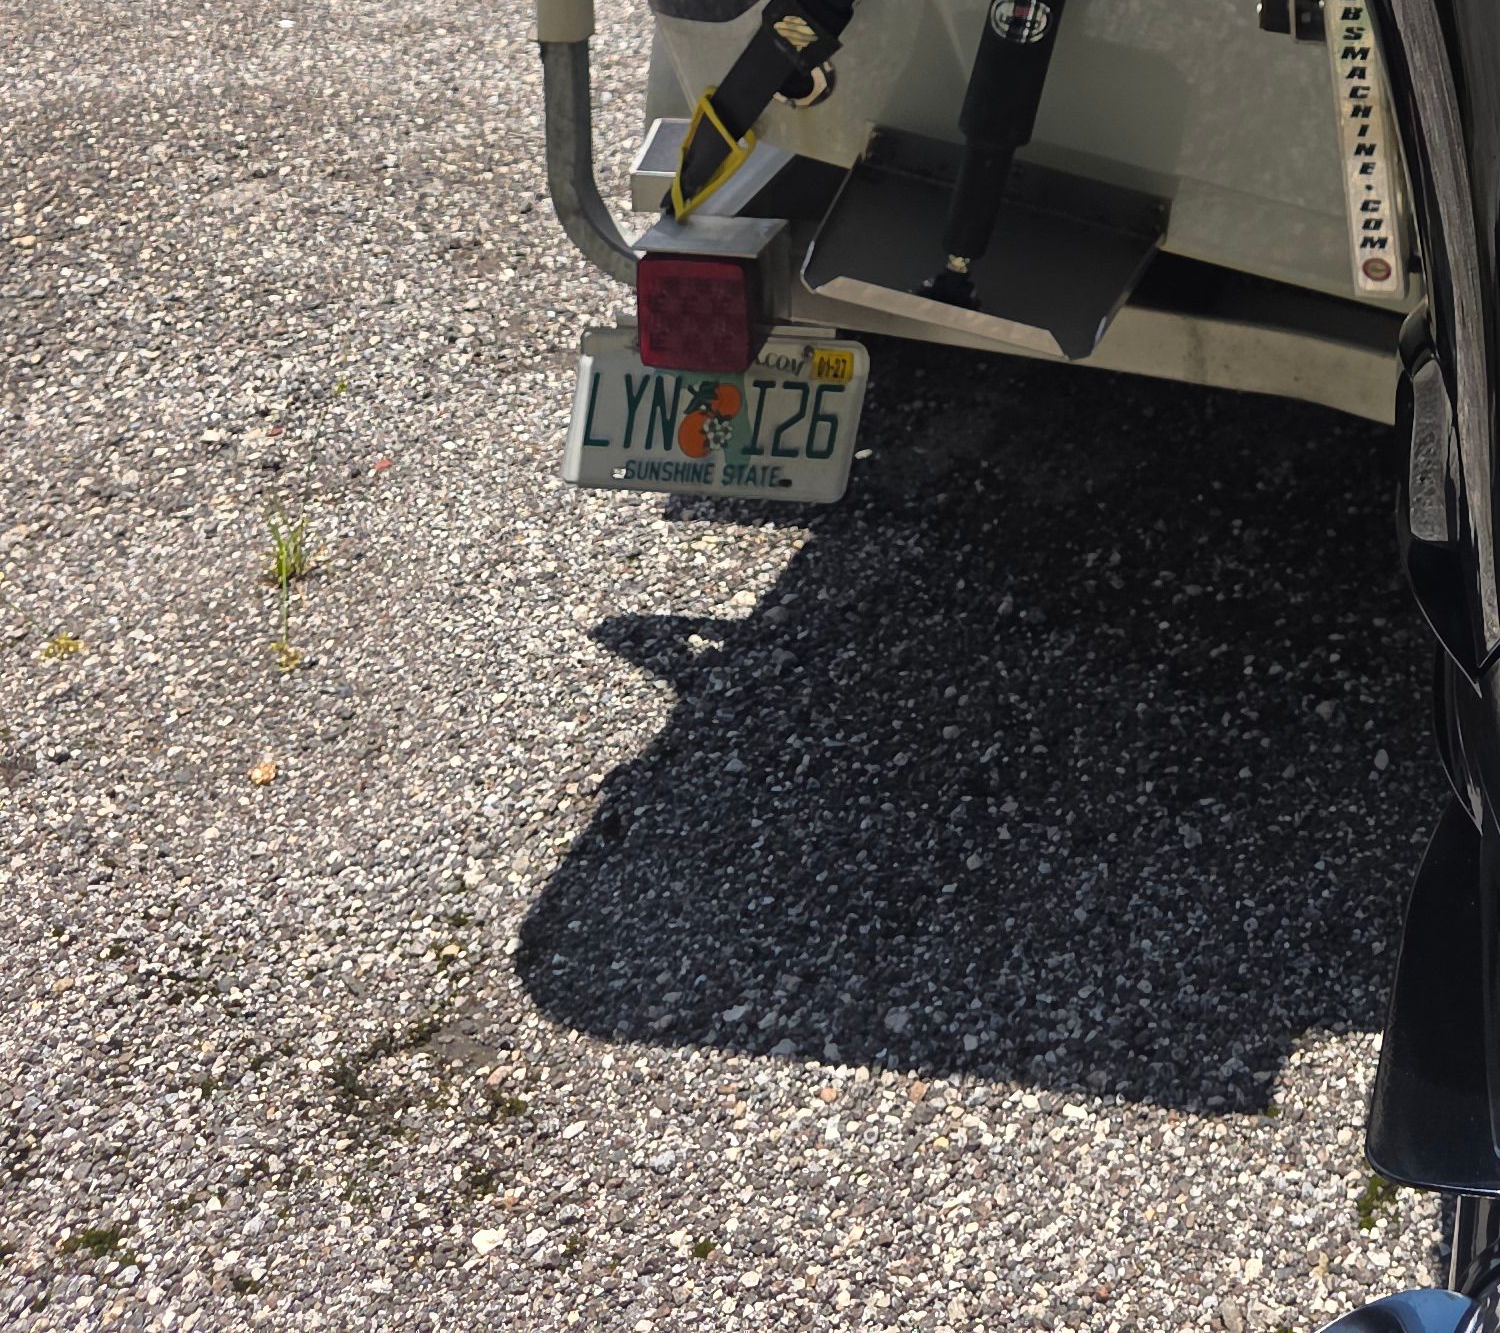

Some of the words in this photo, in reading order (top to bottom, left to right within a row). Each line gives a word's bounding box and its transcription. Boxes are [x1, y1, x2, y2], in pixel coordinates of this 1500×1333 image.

[583, 372, 682, 451] LYN
[624, 459, 713, 482] SUNSHINE
[722, 464, 781, 487] STATE
